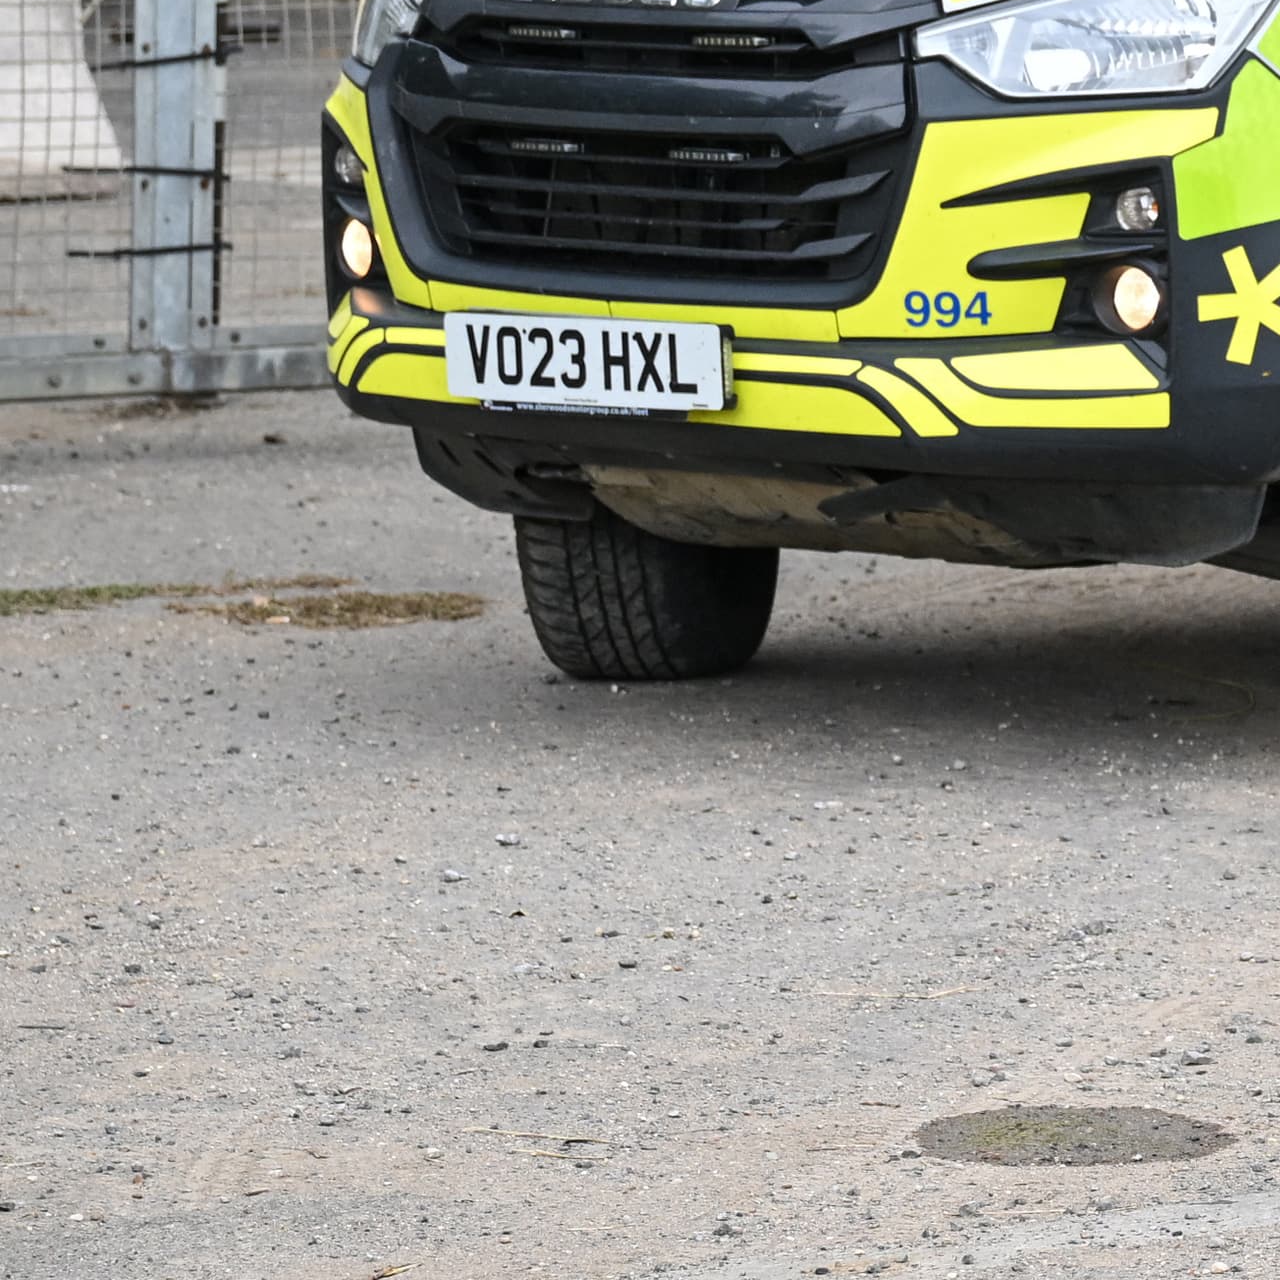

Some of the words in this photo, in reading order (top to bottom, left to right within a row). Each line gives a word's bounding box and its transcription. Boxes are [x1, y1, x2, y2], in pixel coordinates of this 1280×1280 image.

[904, 290, 992, 328] 994
[466, 324, 586, 389] VO23
[602, 330, 698, 394] HXL
